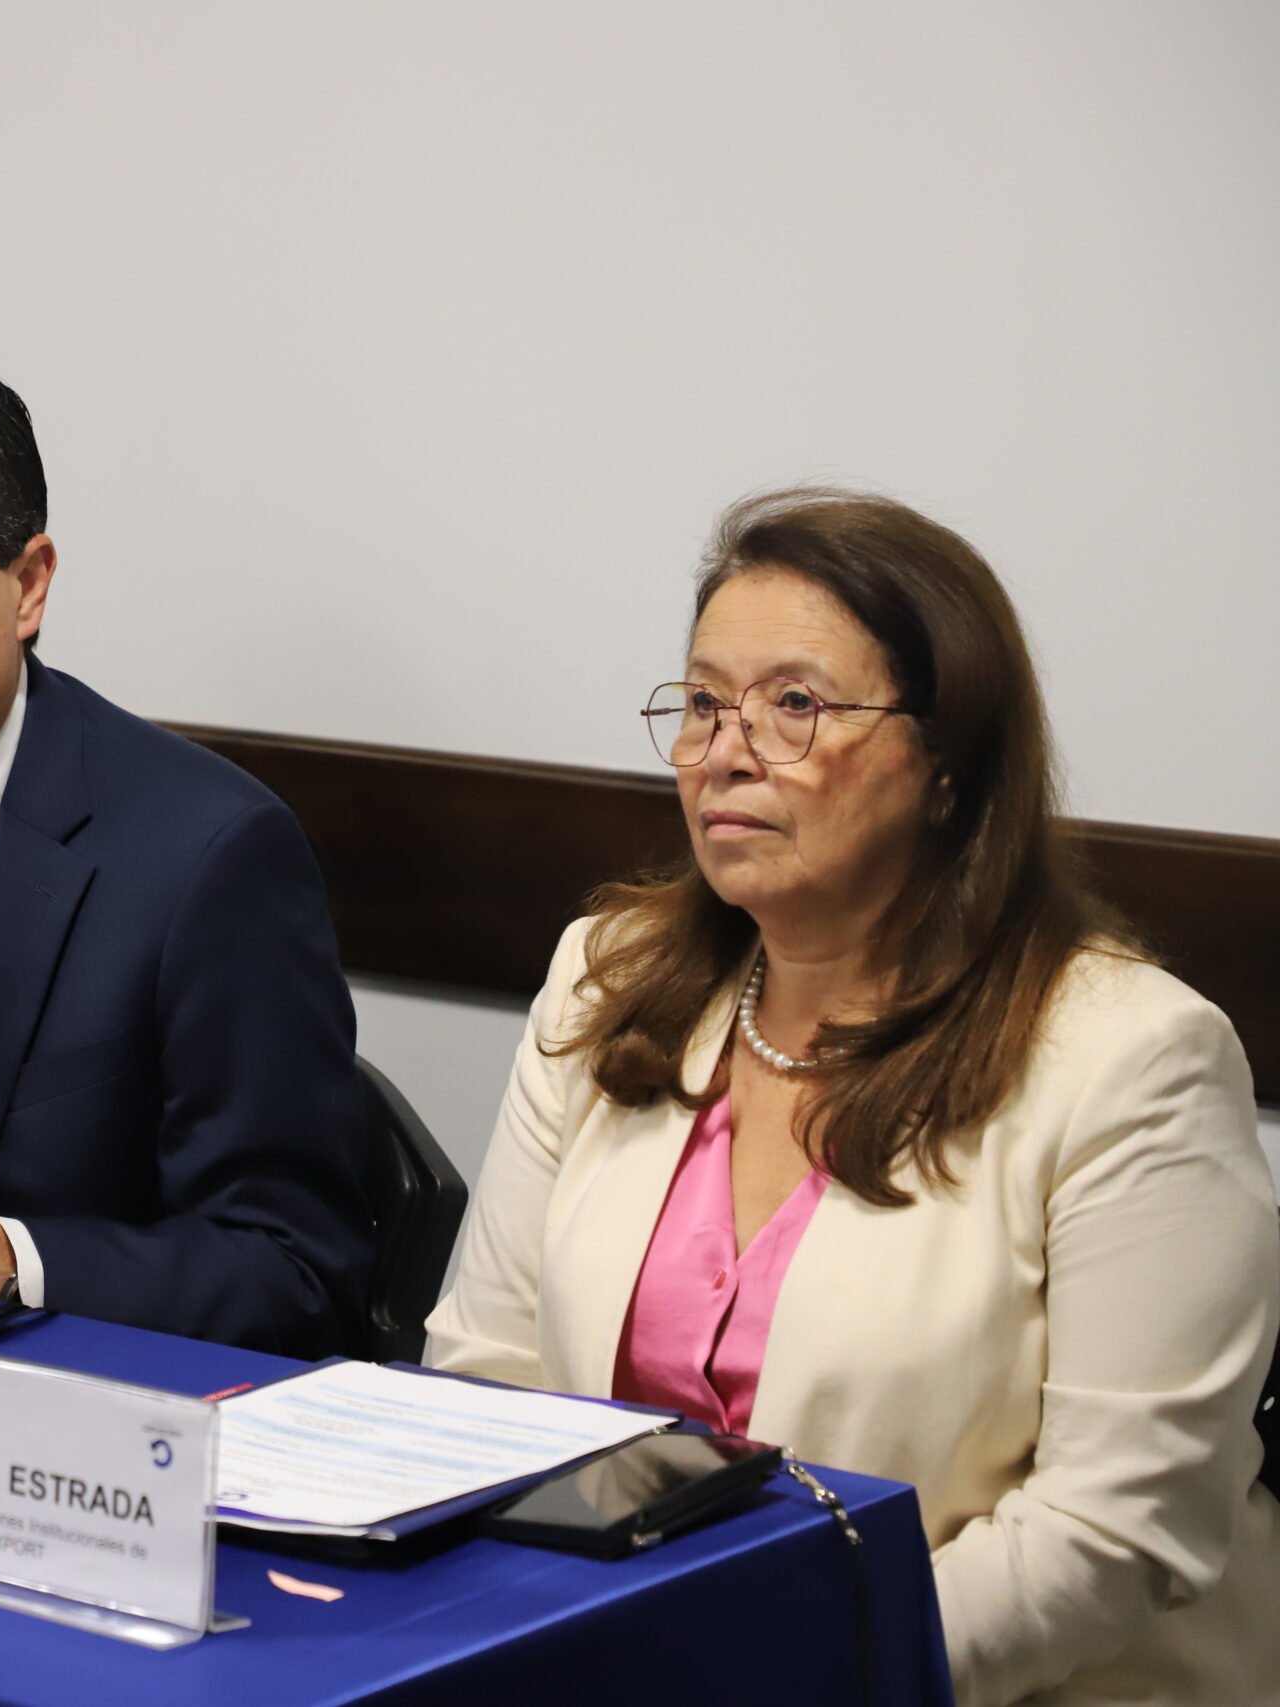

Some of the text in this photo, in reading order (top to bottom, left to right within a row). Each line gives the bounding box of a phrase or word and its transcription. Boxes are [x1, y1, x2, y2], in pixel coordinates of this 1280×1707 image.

[9, 1465, 154, 1527] ESTRADA
[30, 1520, 125, 1555] Institucionales
[131, 1543, 147, 1560] de
